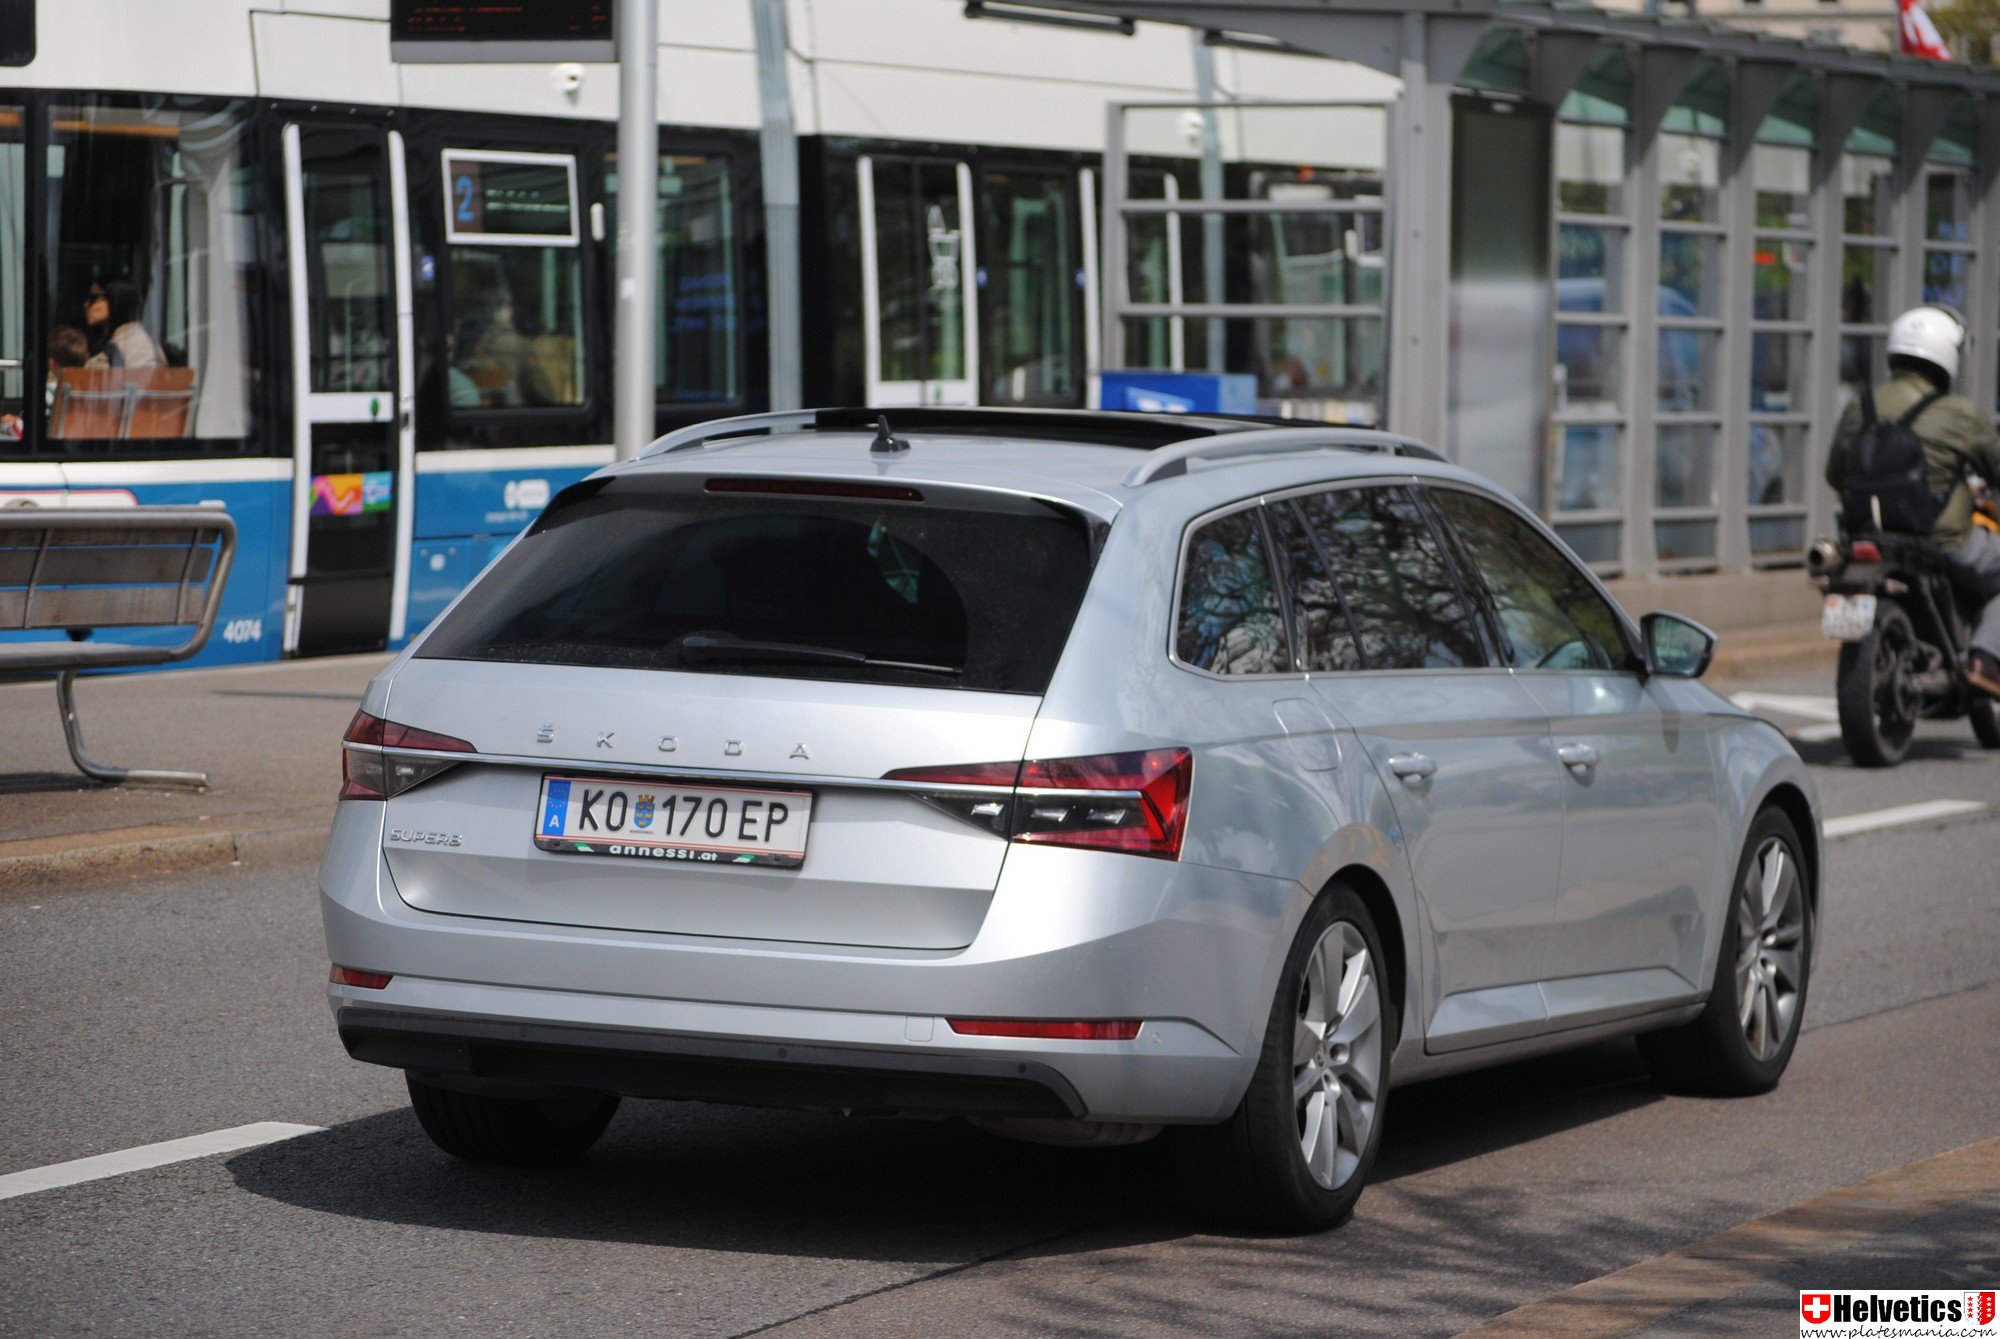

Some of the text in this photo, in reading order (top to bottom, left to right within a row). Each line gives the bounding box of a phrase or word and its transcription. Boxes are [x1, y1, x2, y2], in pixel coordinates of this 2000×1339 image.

[455, 175, 475, 222] 2
[223, 619, 262, 643] 4074
[549, 815, 560, 828] A
[579, 789, 789, 842] KO 170 EP
[390, 828, 462, 847] SUPERB
[609, 842, 718, 861] annessi.at
